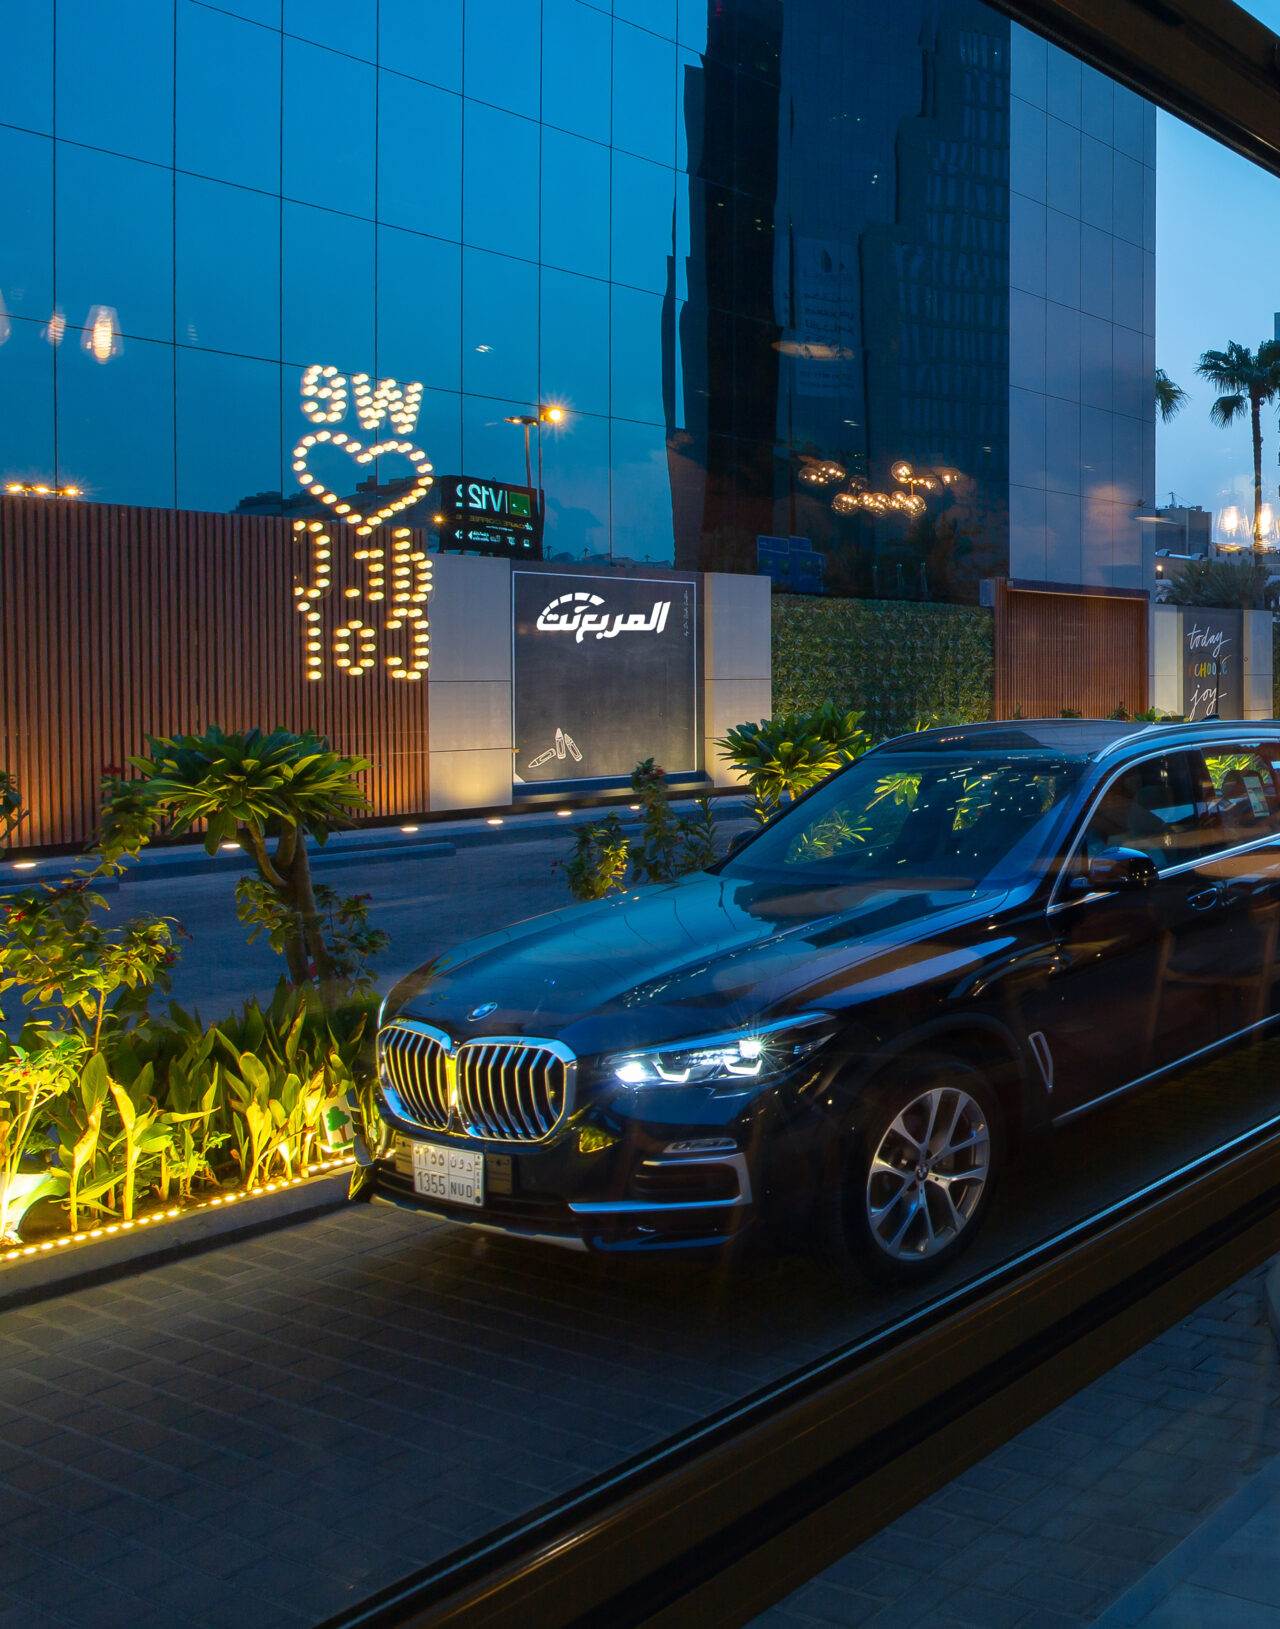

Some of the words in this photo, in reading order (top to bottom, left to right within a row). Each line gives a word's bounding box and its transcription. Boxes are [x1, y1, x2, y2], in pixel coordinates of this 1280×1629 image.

[1187, 623, 1232, 658] today
[1194, 660, 1228, 678] CHOOE
[1189, 684, 1227, 722] joy
[417, 1171, 446, 1195] 1355
[450, 1181, 473, 1198] NUD
